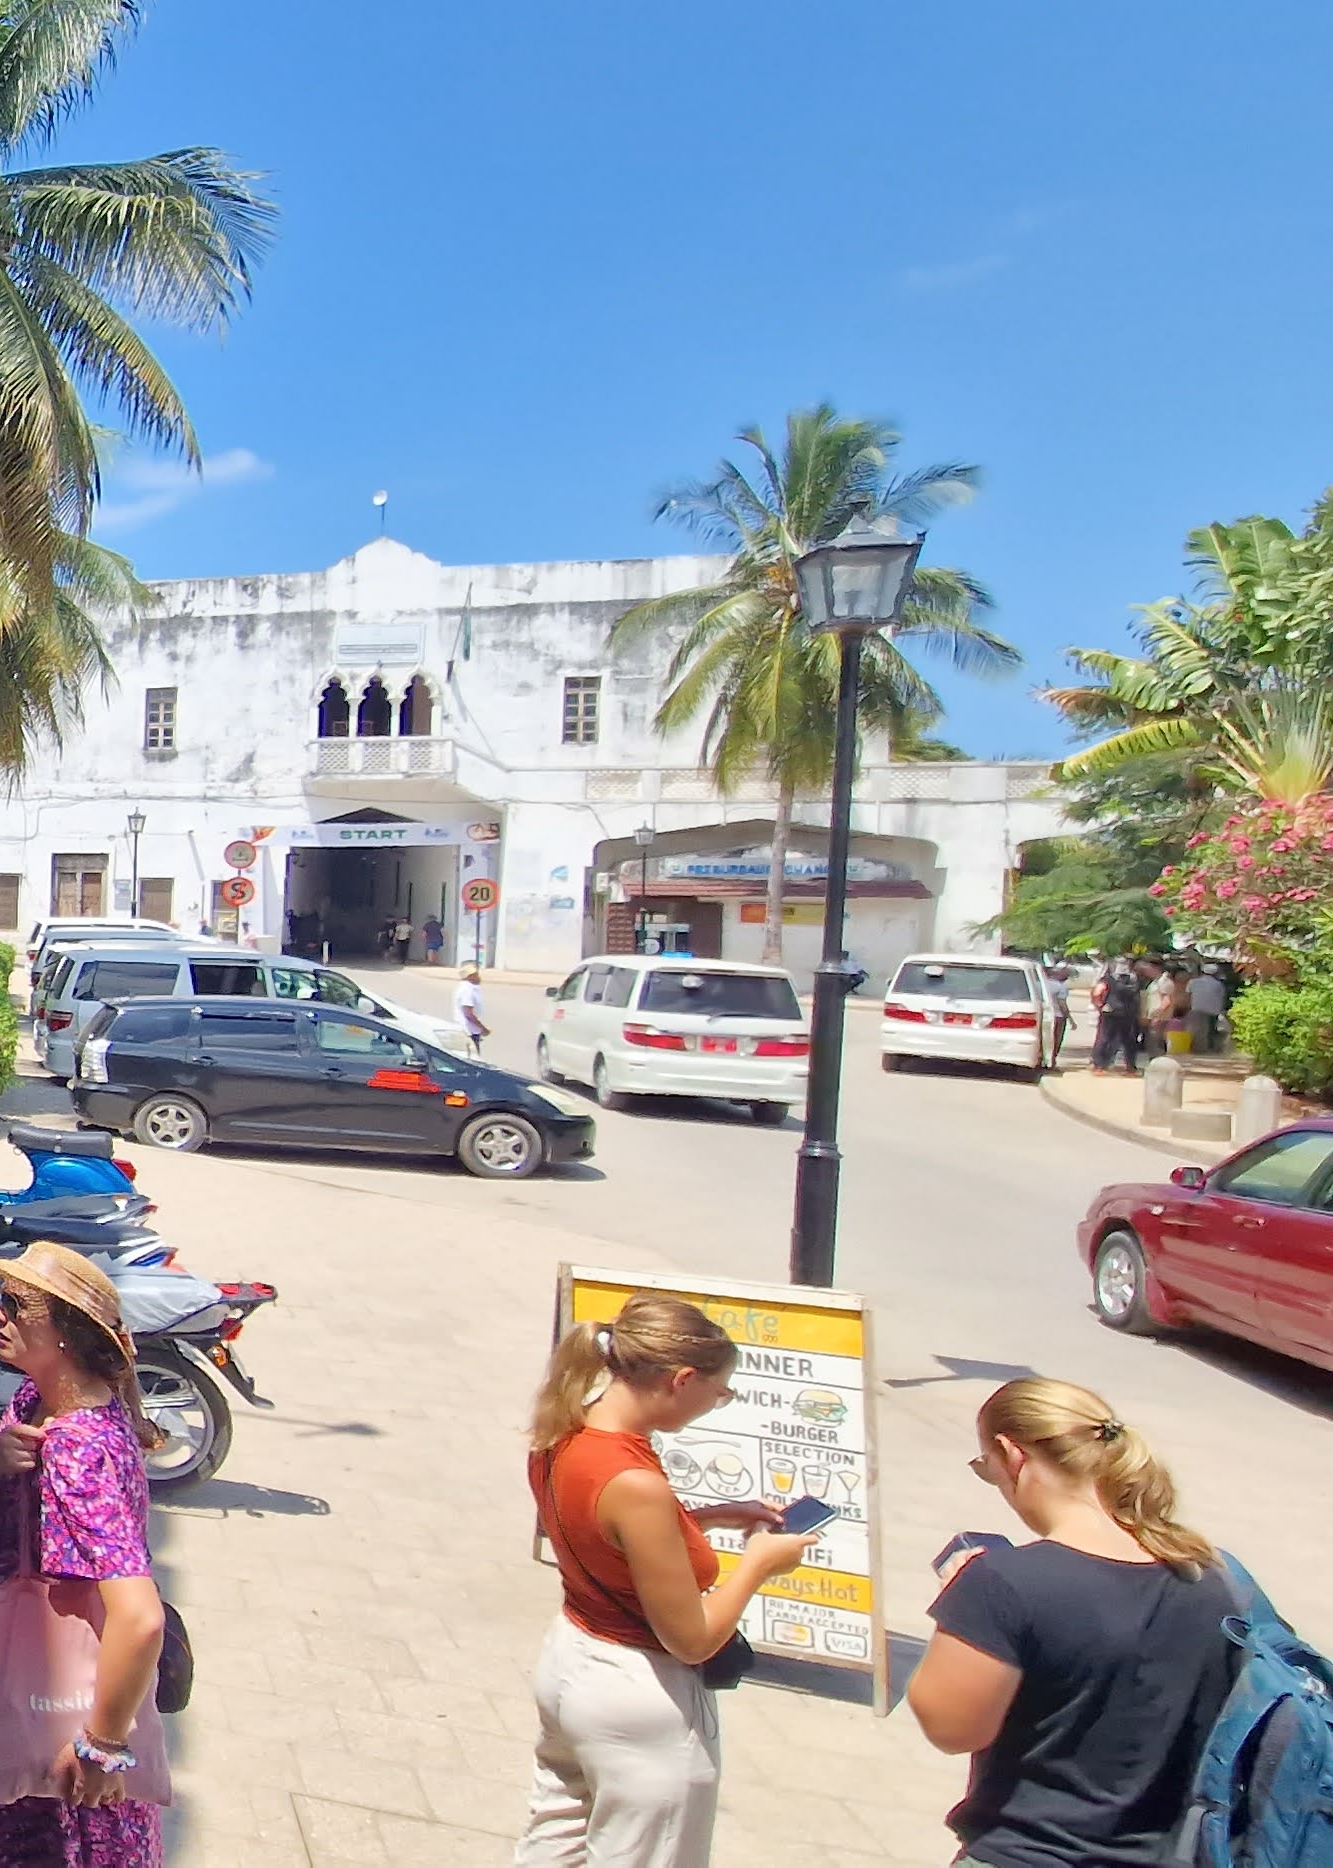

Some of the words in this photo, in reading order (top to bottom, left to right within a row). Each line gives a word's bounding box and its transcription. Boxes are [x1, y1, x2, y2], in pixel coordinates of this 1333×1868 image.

[339, 829, 408, 840] START
[469, 886, 491, 902] 20
[736, 1350, 814, 1377] INNER
[733, 1387, 790, 1409] WICH-
[764, 1441, 855, 1466] SELECTION
[717, 1483, 740, 1493] TEA
[807, 1547, 833, 1566] IFi
[767, 1574, 815, 1597] ways
[820, 1577, 858, 1602] Hot
[789, 1603, 835, 1619] MAJOR
[808, 1619, 869, 1635] ACCEPTED
